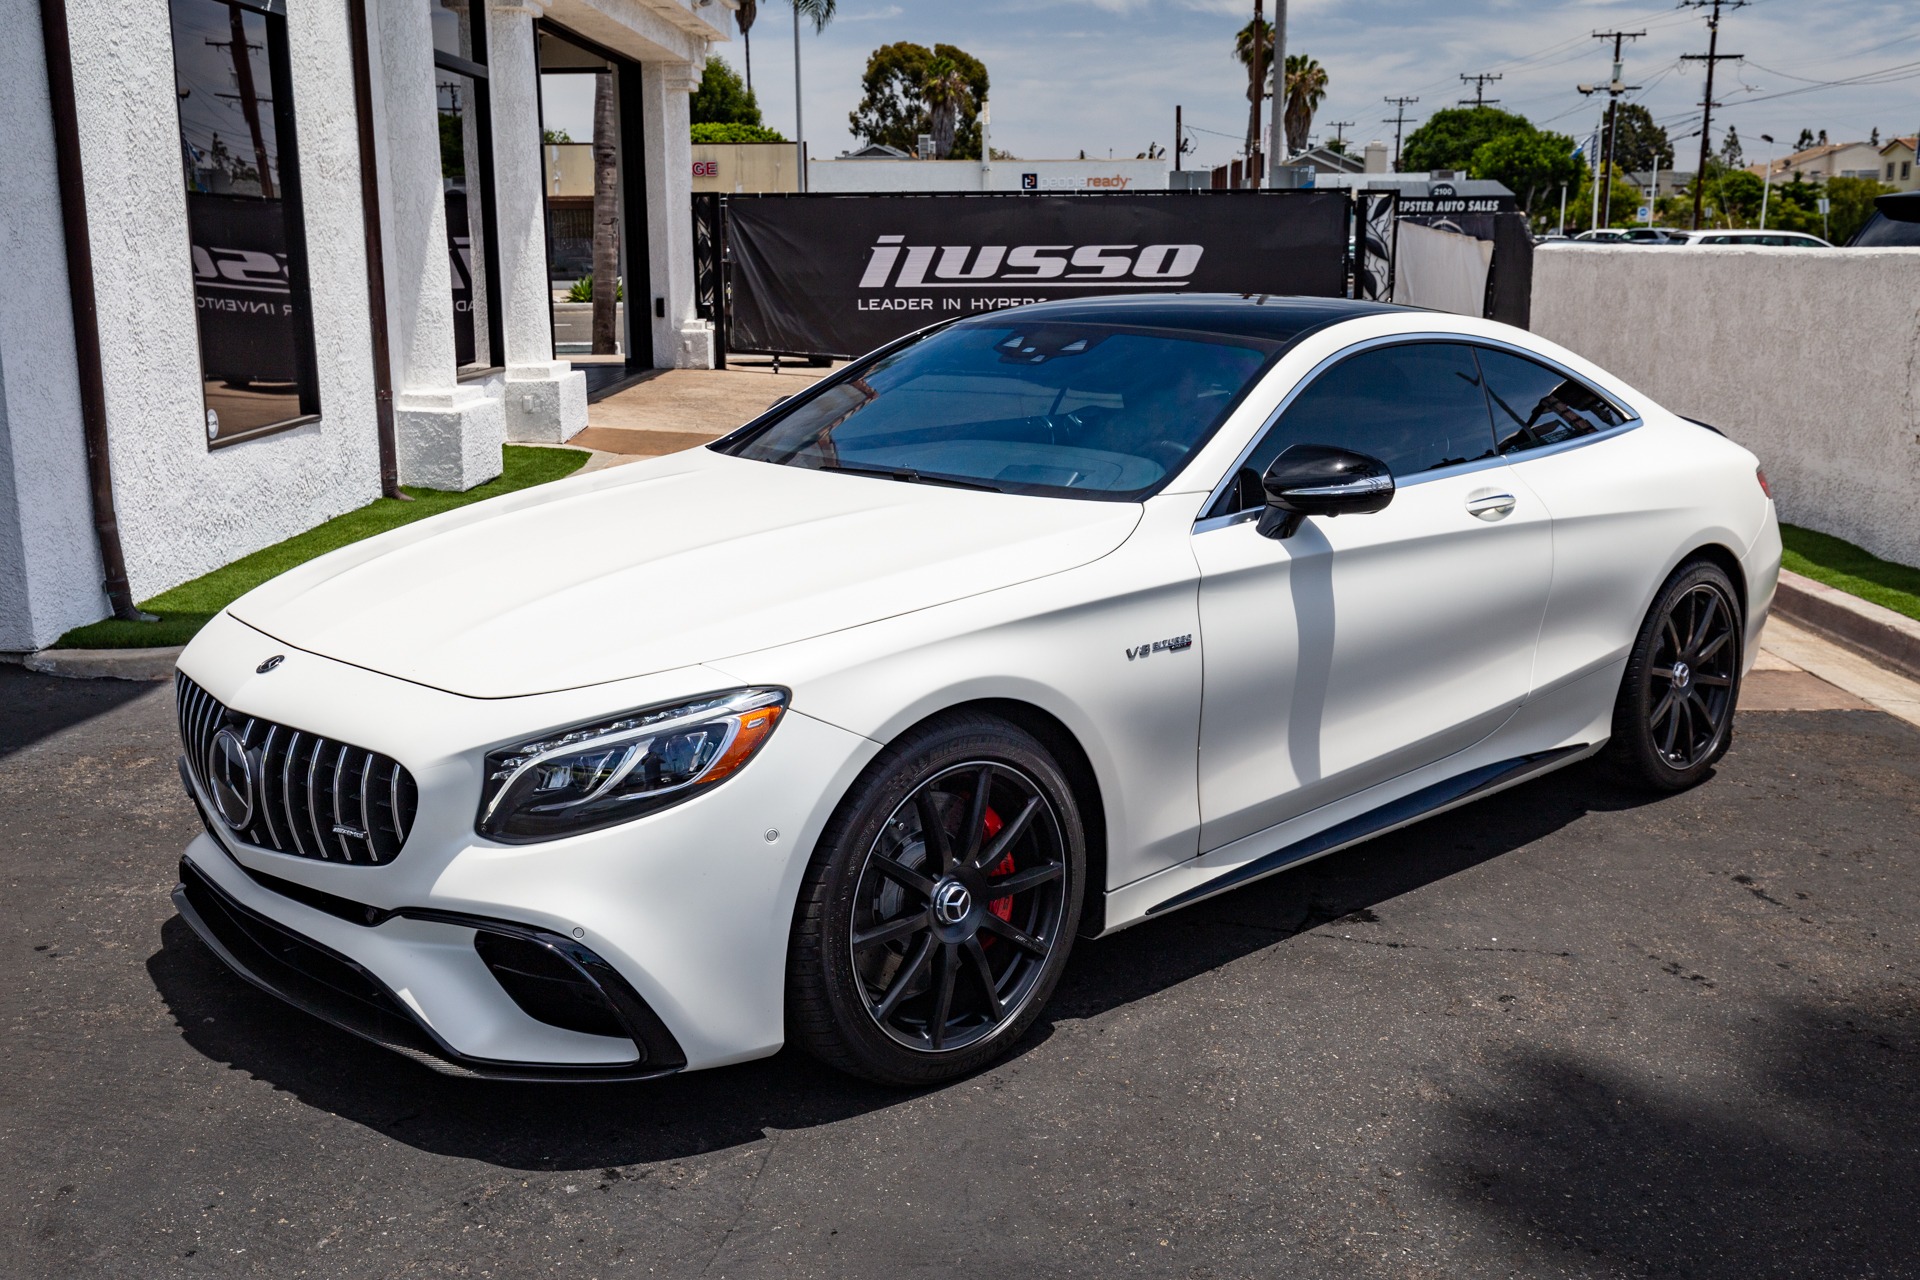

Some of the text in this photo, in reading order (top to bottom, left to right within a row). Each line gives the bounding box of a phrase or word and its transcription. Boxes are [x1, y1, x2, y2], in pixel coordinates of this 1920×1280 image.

[692, 161, 718, 177] GE
[1433, 188, 1453, 196] 2100
[1436, 201, 1465, 212] AUTO
[1468, 200, 1499, 212] SALES
[857, 298, 934, 311] LEADER
[942, 298, 961, 310] IN
[1125, 644, 1151, 660] V8
